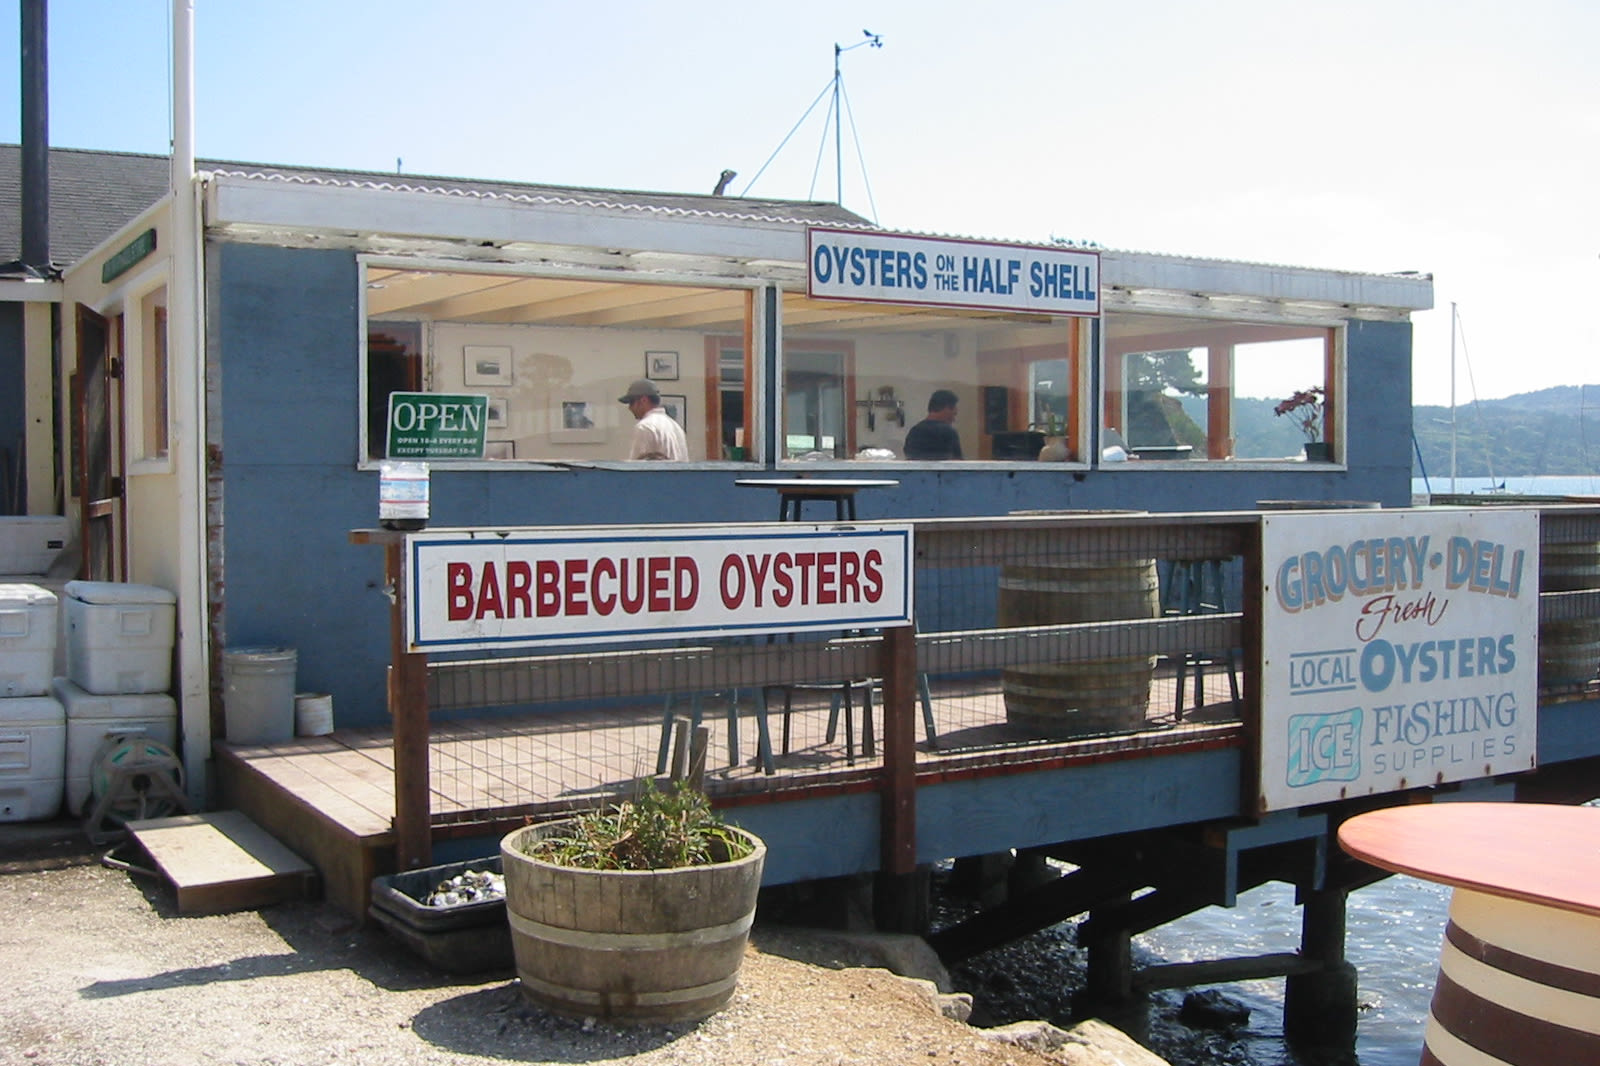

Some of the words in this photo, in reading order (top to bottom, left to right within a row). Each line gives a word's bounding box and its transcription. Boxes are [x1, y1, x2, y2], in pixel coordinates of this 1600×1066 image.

[814, 244, 928, 290] OYSTERS
[934, 273, 960, 292] THE
[936, 254, 955, 272] ON
[963, 256, 1021, 295] HALF
[1030, 261, 1096, 301] SHELL
[393, 402, 482, 431] OPEN
[447, 556, 699, 622] BARBECUED
[719, 549, 884, 610] OYSTERS
[1275, 535, 1430, 614] GROCERY
[1445, 536, 1525, 599] DELI
[1355, 591, 1449, 642] Fresh
[1290, 655, 1357, 689] LOCAL
[1359, 634, 1517, 693] OYSTERS
[1370, 691, 1517, 747] FISHING
[1298, 722, 1353, 774] ICE
[1373, 735, 1517, 775] SUPPLIES
